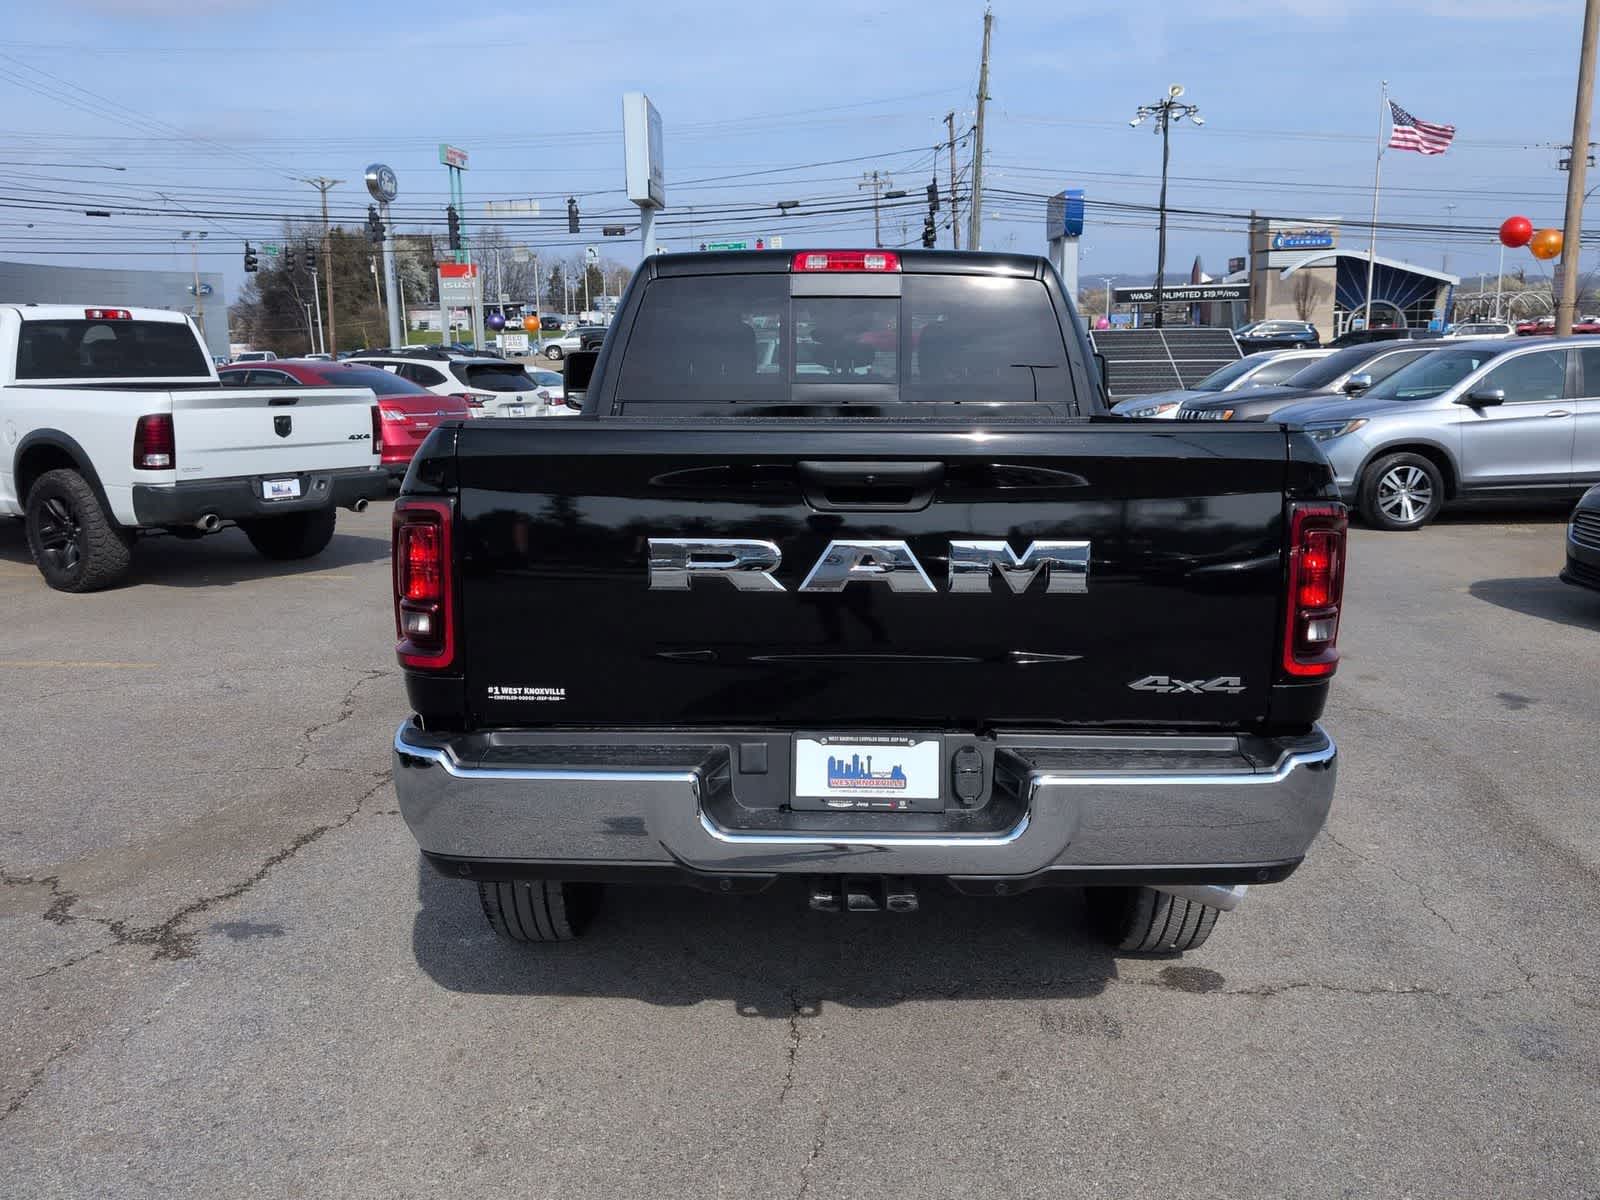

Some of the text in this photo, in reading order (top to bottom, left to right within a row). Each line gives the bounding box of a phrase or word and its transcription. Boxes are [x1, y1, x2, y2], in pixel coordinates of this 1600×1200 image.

[1162, 291, 1201, 299] NLIMITED
[648, 537, 1091, 593] RAM
[501, 687, 523, 695] WEST
[524, 687, 566, 695] KNOXVILLE
